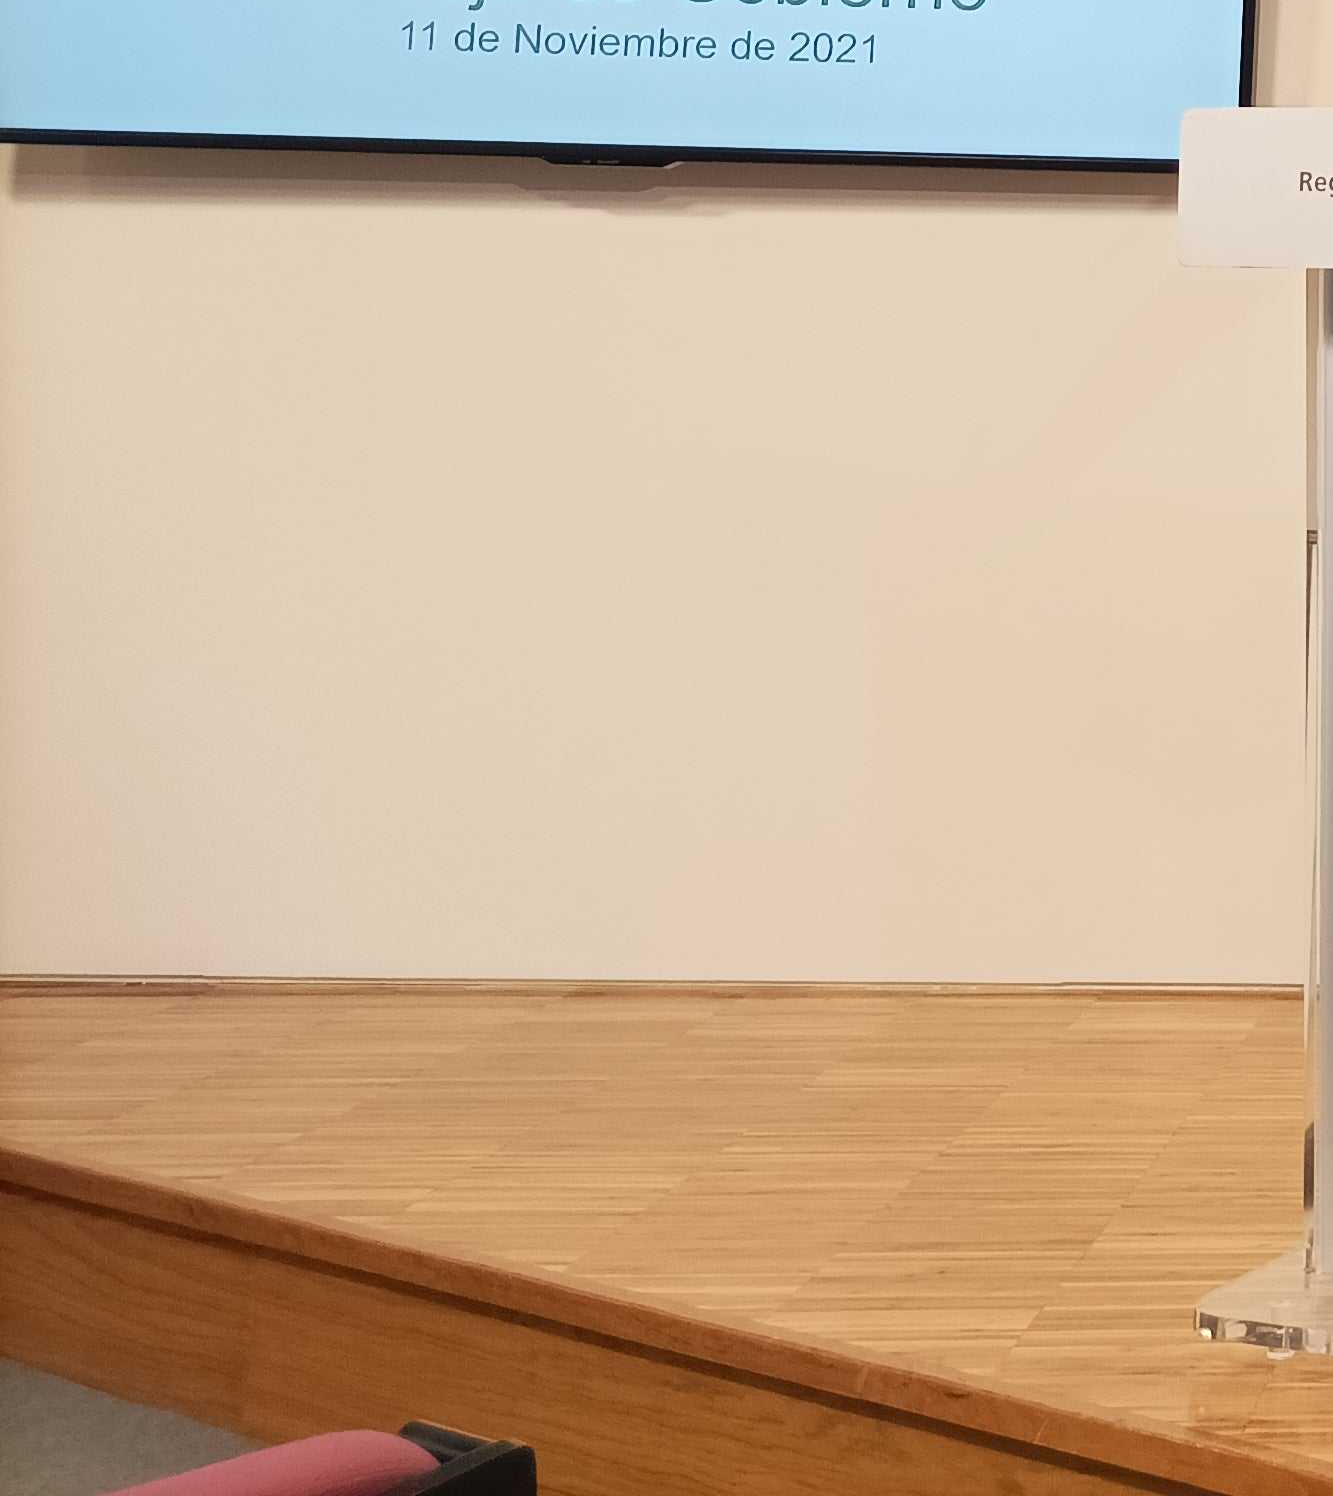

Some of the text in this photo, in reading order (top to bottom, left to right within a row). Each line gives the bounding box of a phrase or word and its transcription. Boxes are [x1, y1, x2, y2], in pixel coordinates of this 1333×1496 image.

[401, 20, 876, 64] 11 de Noviembre de 2021
